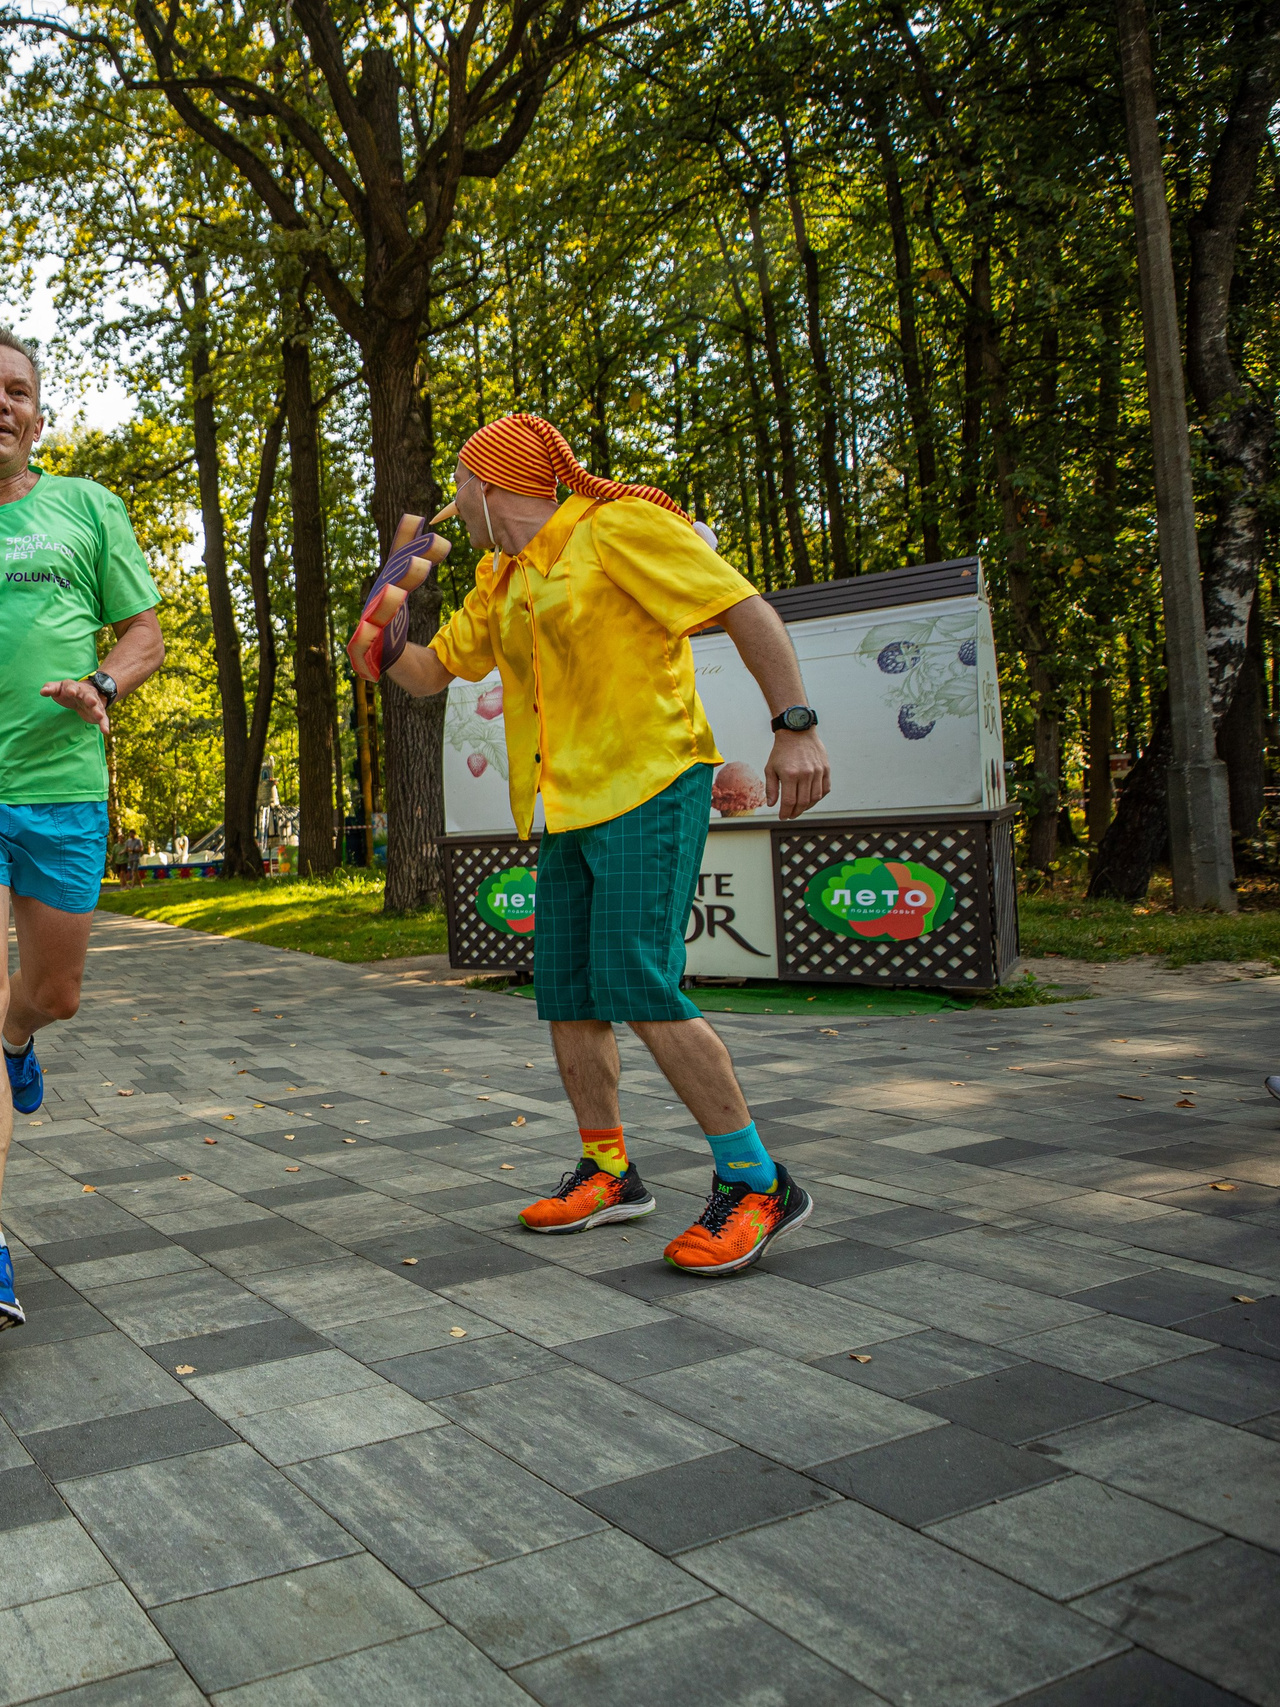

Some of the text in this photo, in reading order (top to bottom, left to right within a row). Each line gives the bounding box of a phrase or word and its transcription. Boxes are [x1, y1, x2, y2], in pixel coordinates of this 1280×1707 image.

[6, 534, 47, 545] SPORT
[5, 550, 36, 560] FEST
[493, 893, 535, 908] лет
[830, 889, 927, 907] лето
